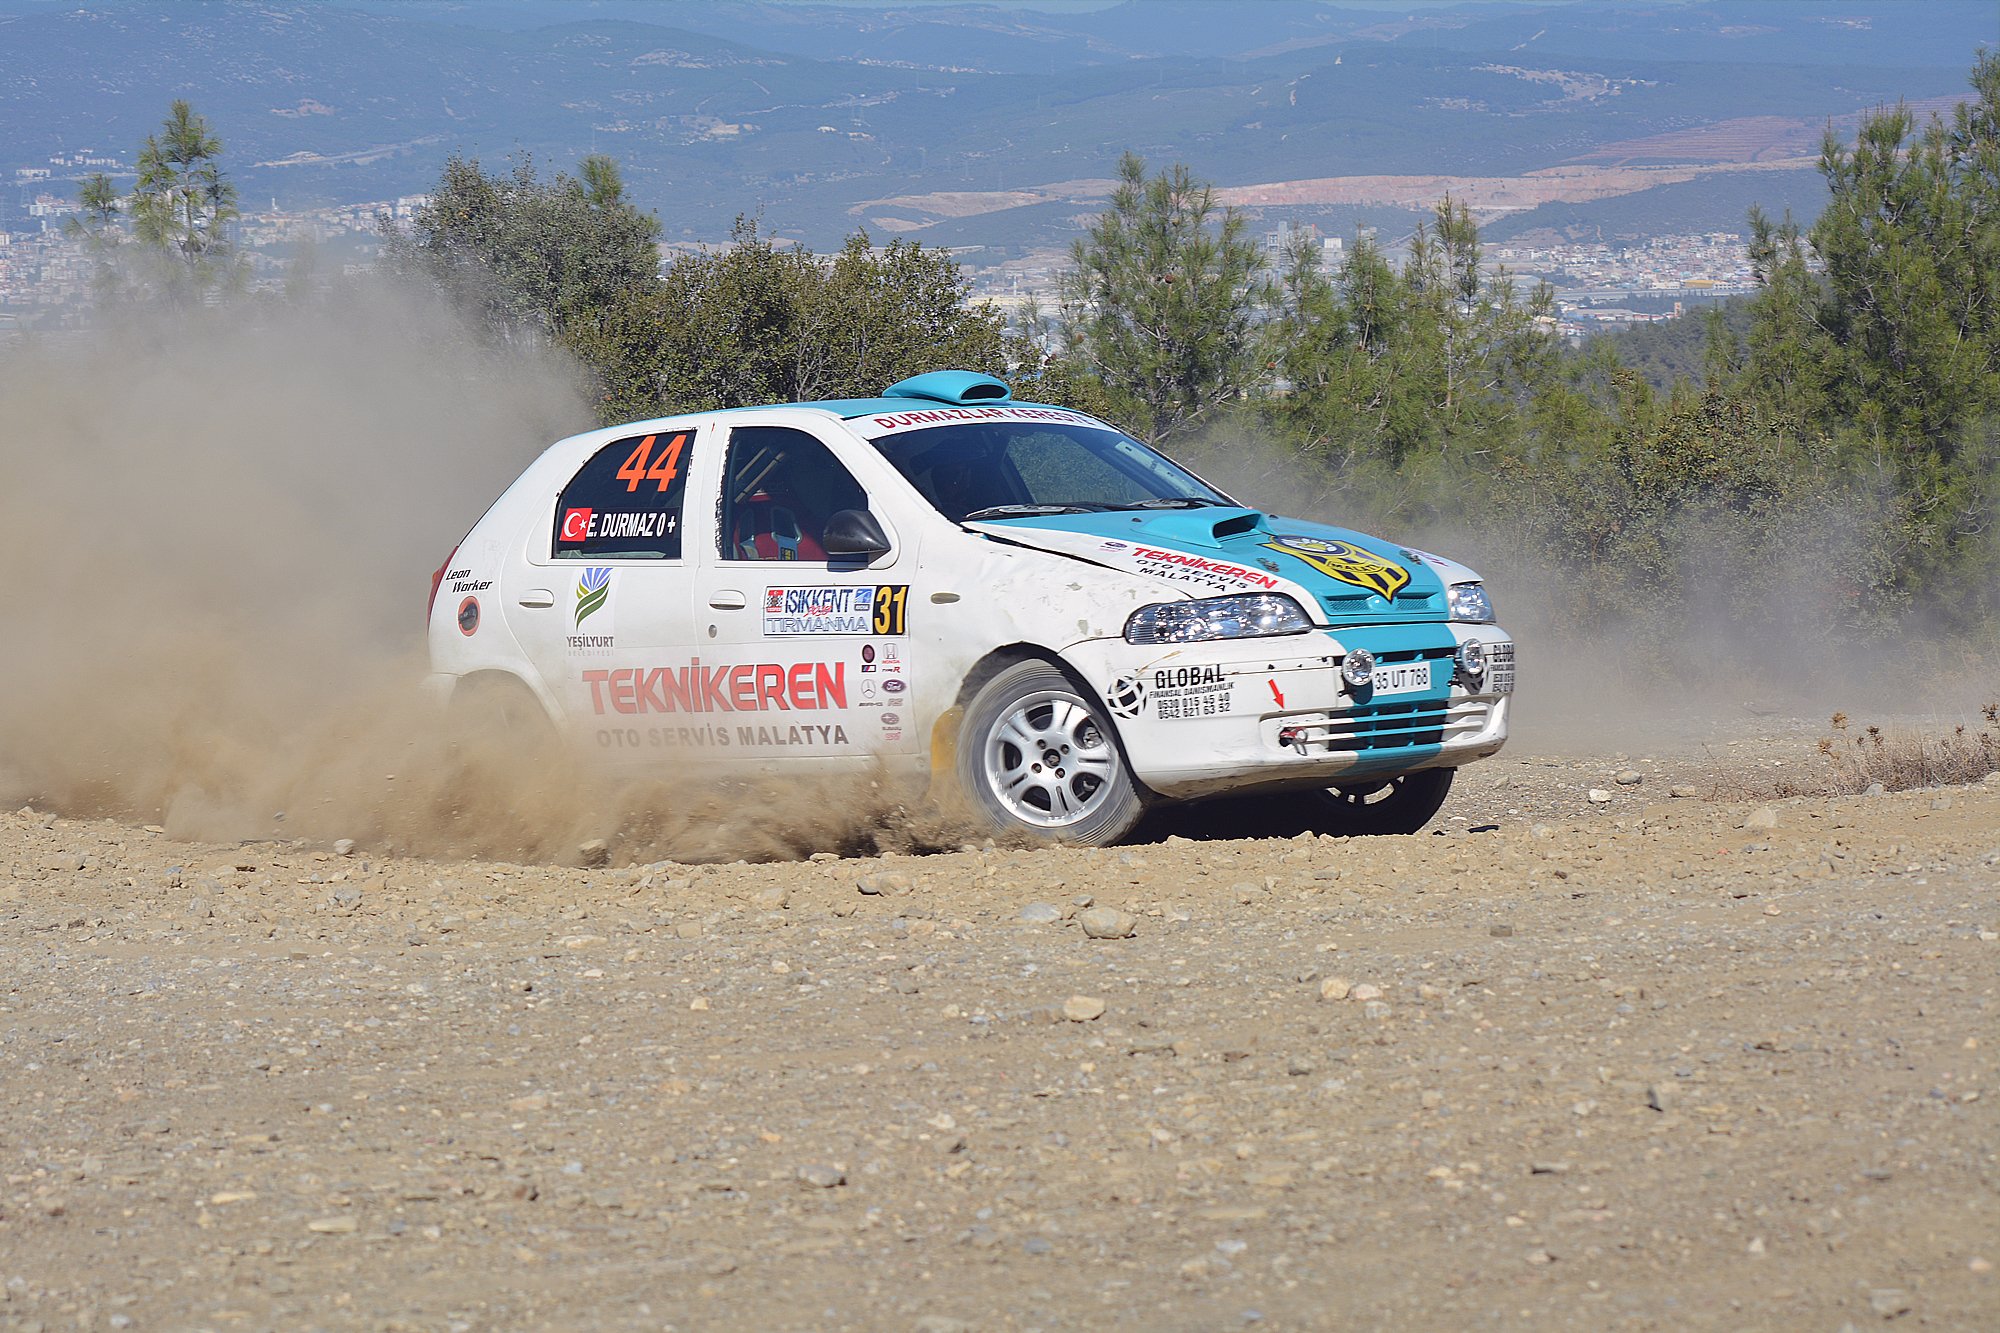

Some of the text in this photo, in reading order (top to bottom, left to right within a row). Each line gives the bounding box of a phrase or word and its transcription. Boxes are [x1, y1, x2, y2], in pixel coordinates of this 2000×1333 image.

[874, 408, 1011, 429] DURMAZLAR
[615, 434, 688, 492] 44
[600, 512, 658, 538] DURMAZ
[446, 569, 472, 581] Leon
[1136, 559, 1174, 570] OTO
[452, 579, 493, 594] Worker
[1139, 567, 1227, 592] MALATYA
[874, 586, 907, 635] 31
[566, 633, 614, 650] YEŞİLYURT
[581, 656, 848, 715] TEKNİKEREN
[1155, 664, 1225, 689] GLOBAL
[1374, 667, 1429, 690] 35 UT 768
[1158, 692, 1231, 710] 0530 015 45 40
[1158, 703, 1231, 720] 0542 621 63 52
[596, 722, 850, 749] OTO SERVİS MALATYA
